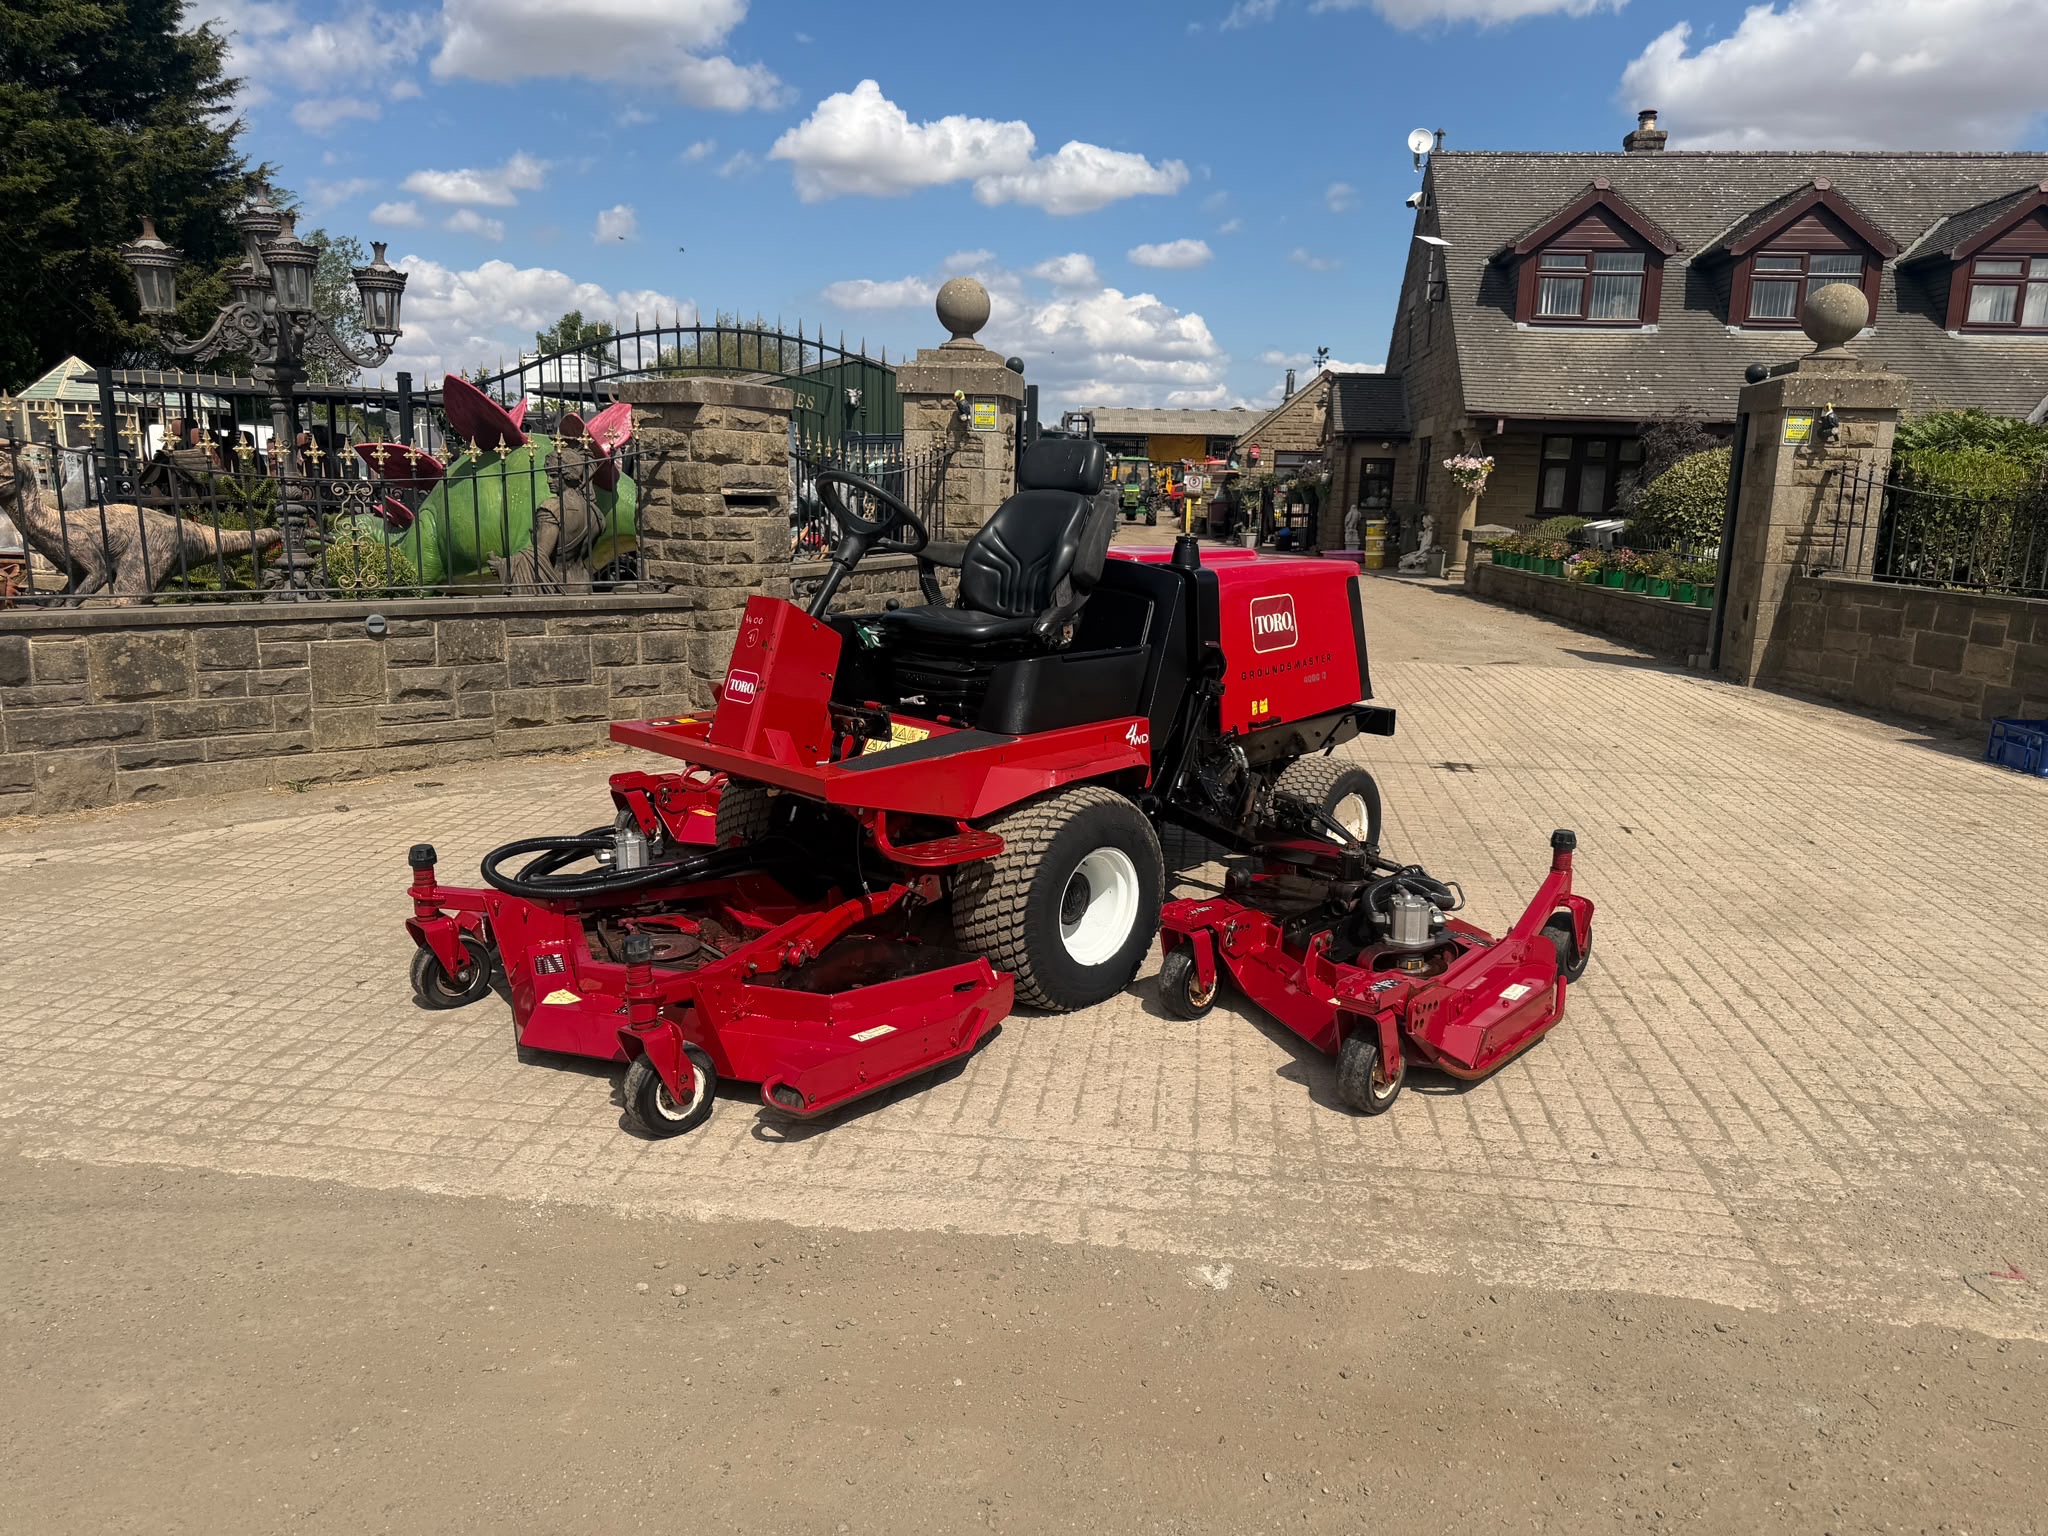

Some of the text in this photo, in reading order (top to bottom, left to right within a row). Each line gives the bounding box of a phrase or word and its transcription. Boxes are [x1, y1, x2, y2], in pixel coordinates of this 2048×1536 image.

[1254, 611, 1292, 635] TORO
[1241, 653, 1332, 681] GROUNDSMASTER
[730, 678, 754, 694] TORO
